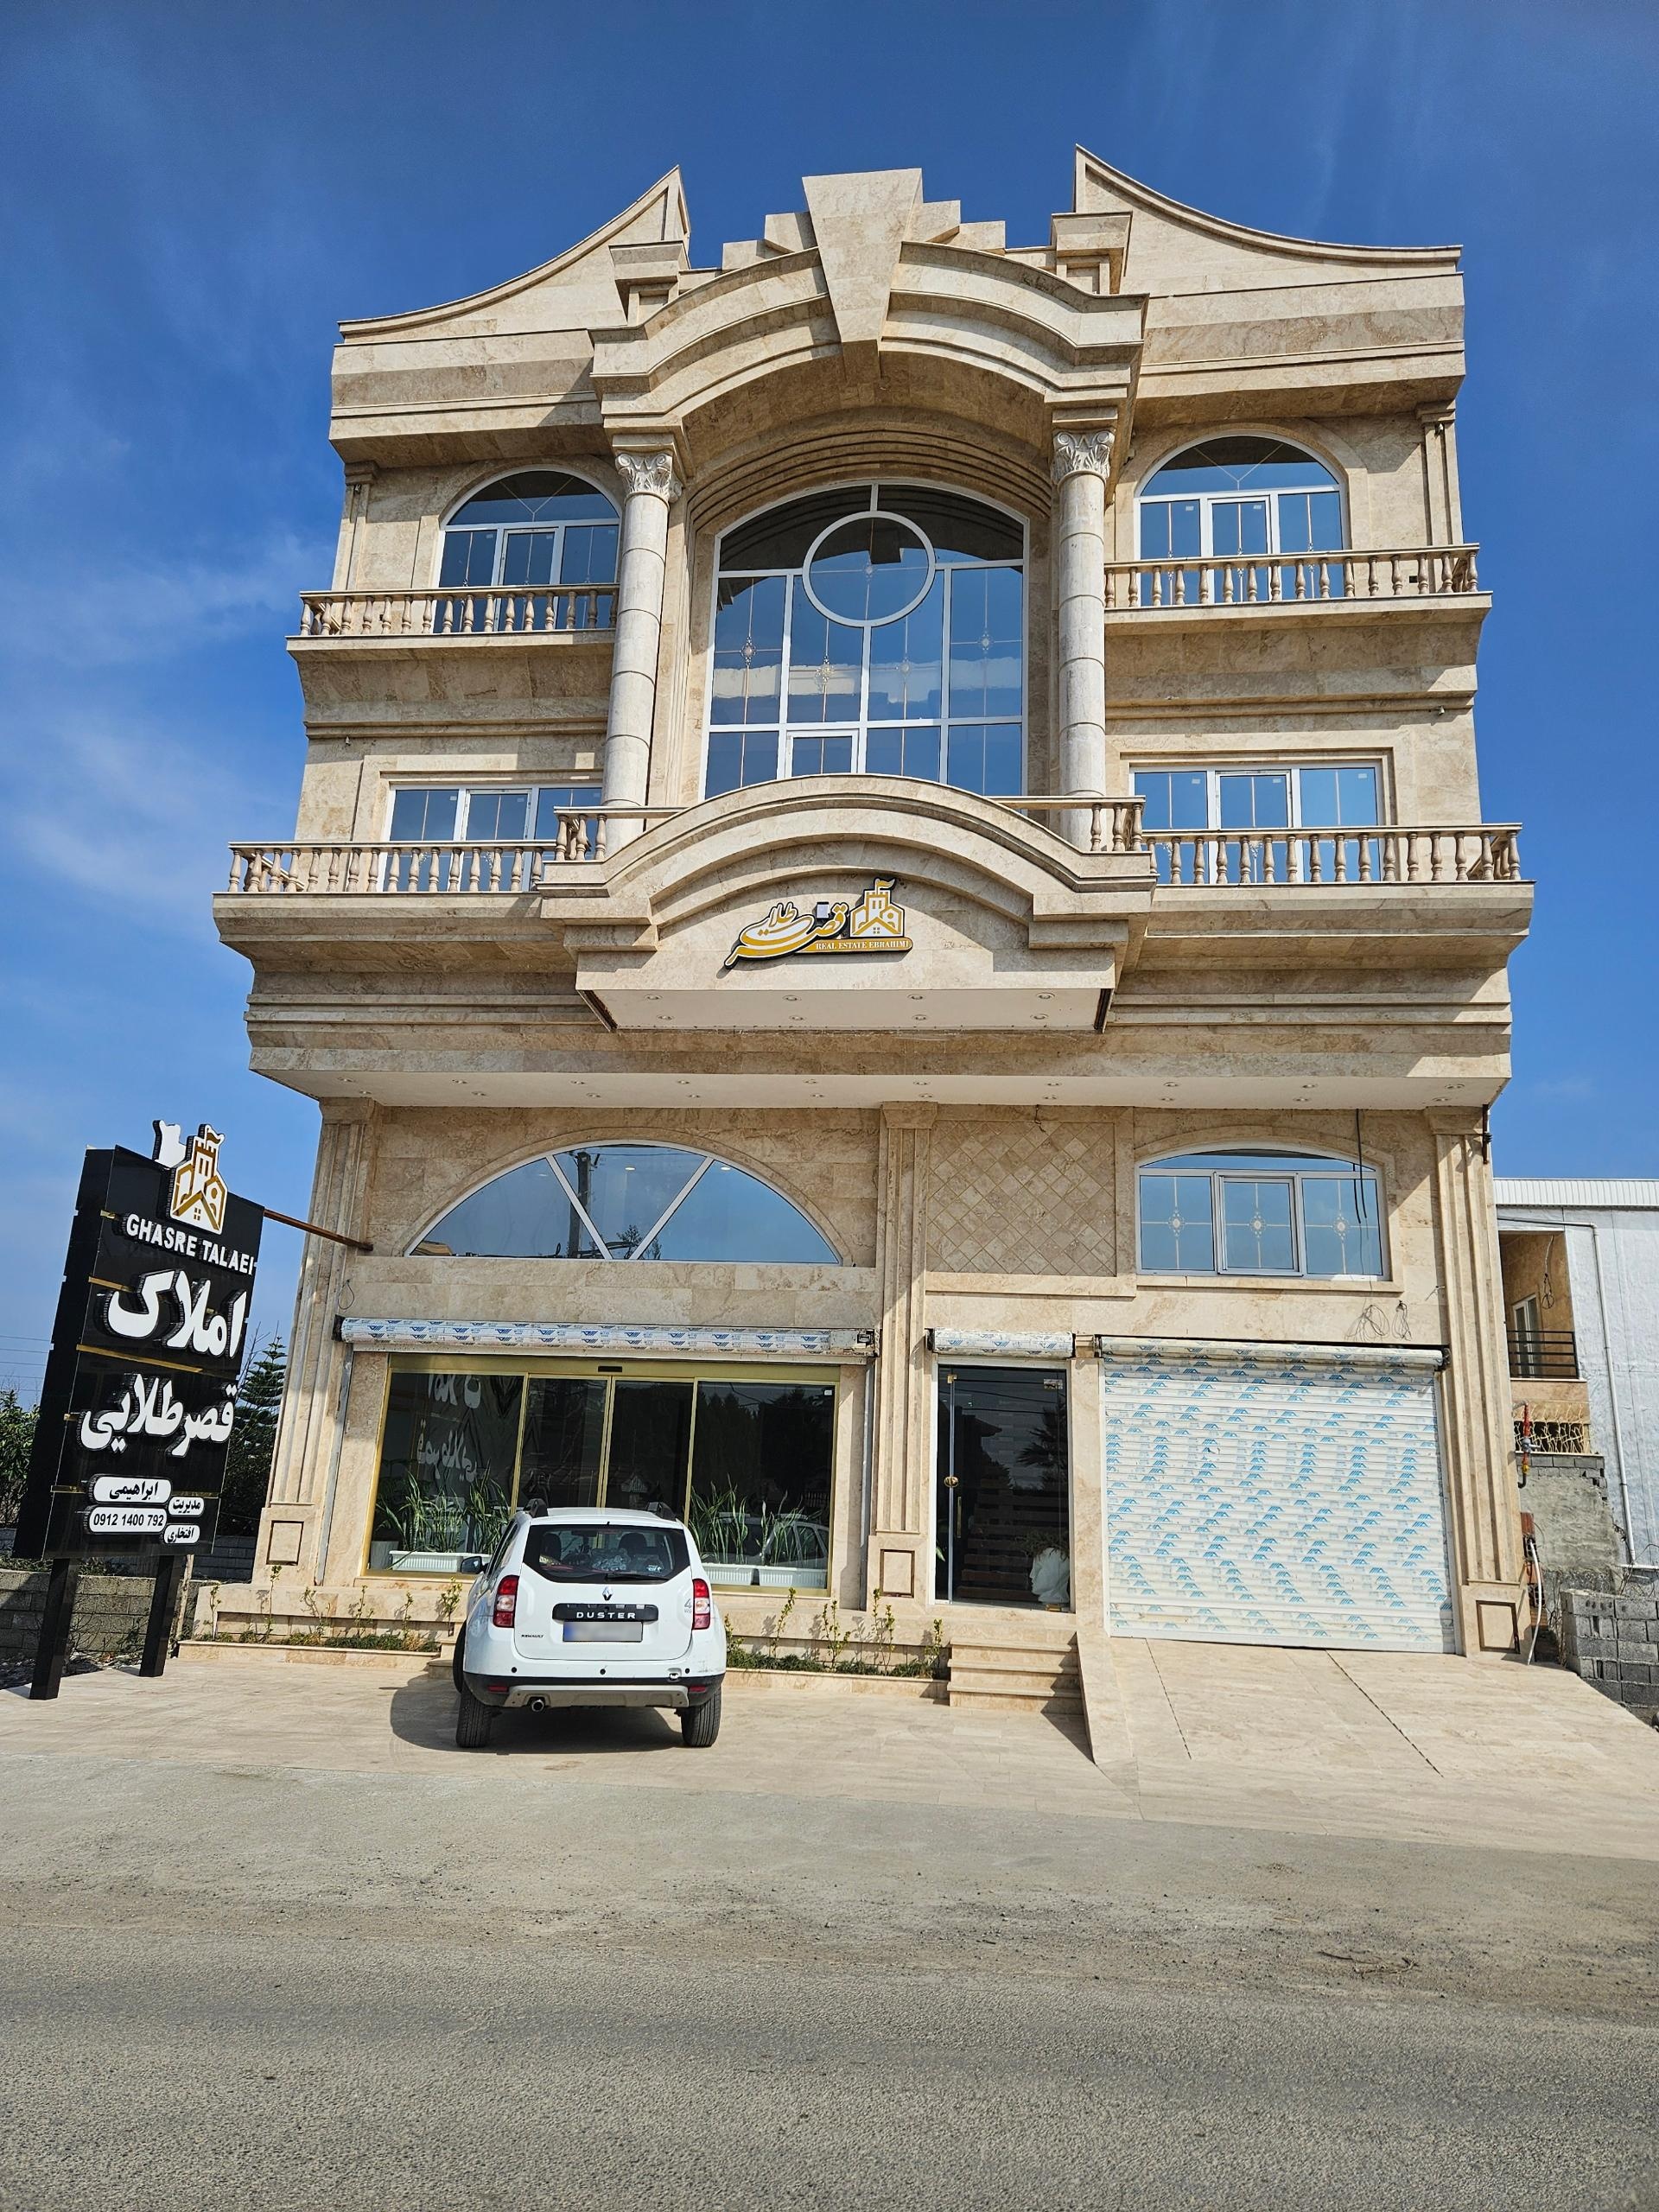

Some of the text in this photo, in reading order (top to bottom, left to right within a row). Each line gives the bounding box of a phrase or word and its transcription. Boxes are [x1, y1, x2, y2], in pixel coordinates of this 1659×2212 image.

[868, 940, 910, 949] EBRAHIMI
[126, 1213, 255, 1275] GHASRE TALAEI
[107, 1270, 247, 1358] املاک
[80, 1373, 238, 1458] قصر طلایی
[109, 1480, 159, 1501] ابراهیمی
[173, 1498, 201, 1514] مدیریت
[93, 1513, 164, 1527] 0912 1400 792
[575, 1611, 637, 1619] DUSTER
